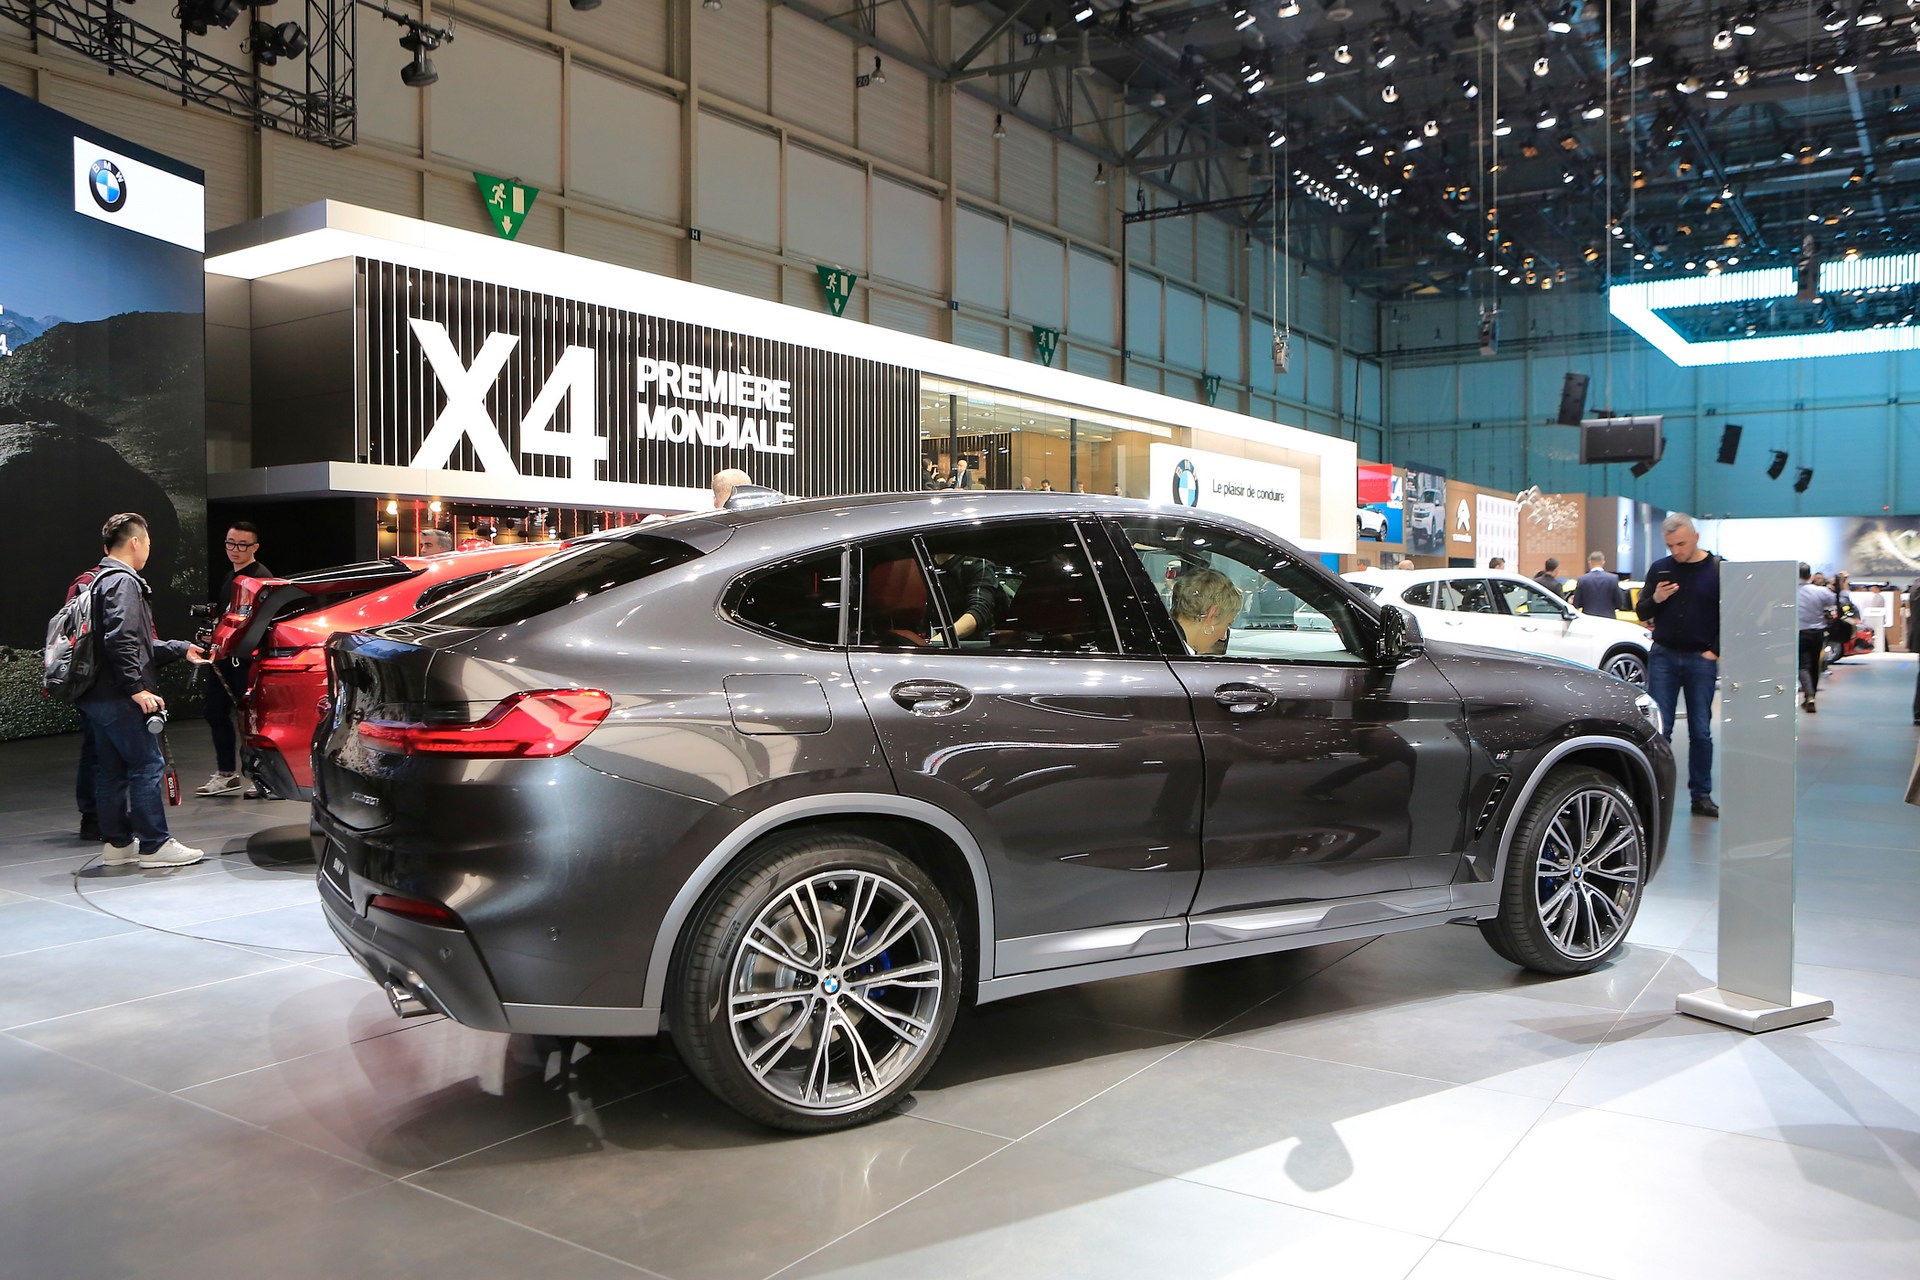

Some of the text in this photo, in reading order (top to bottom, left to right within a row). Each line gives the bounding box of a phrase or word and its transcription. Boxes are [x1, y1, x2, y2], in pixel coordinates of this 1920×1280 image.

[1026, 32, 1037, 45] 19
[92, 160, 125, 183] BMW
[691, 229, 698, 240] H
[637, 356, 792, 415] PREMIÈRE
[407, 317, 608, 481] X4
[637, 402, 795, 456] MONDIALE
[1212, 478, 1285, 503] Le plaisir de conduire
